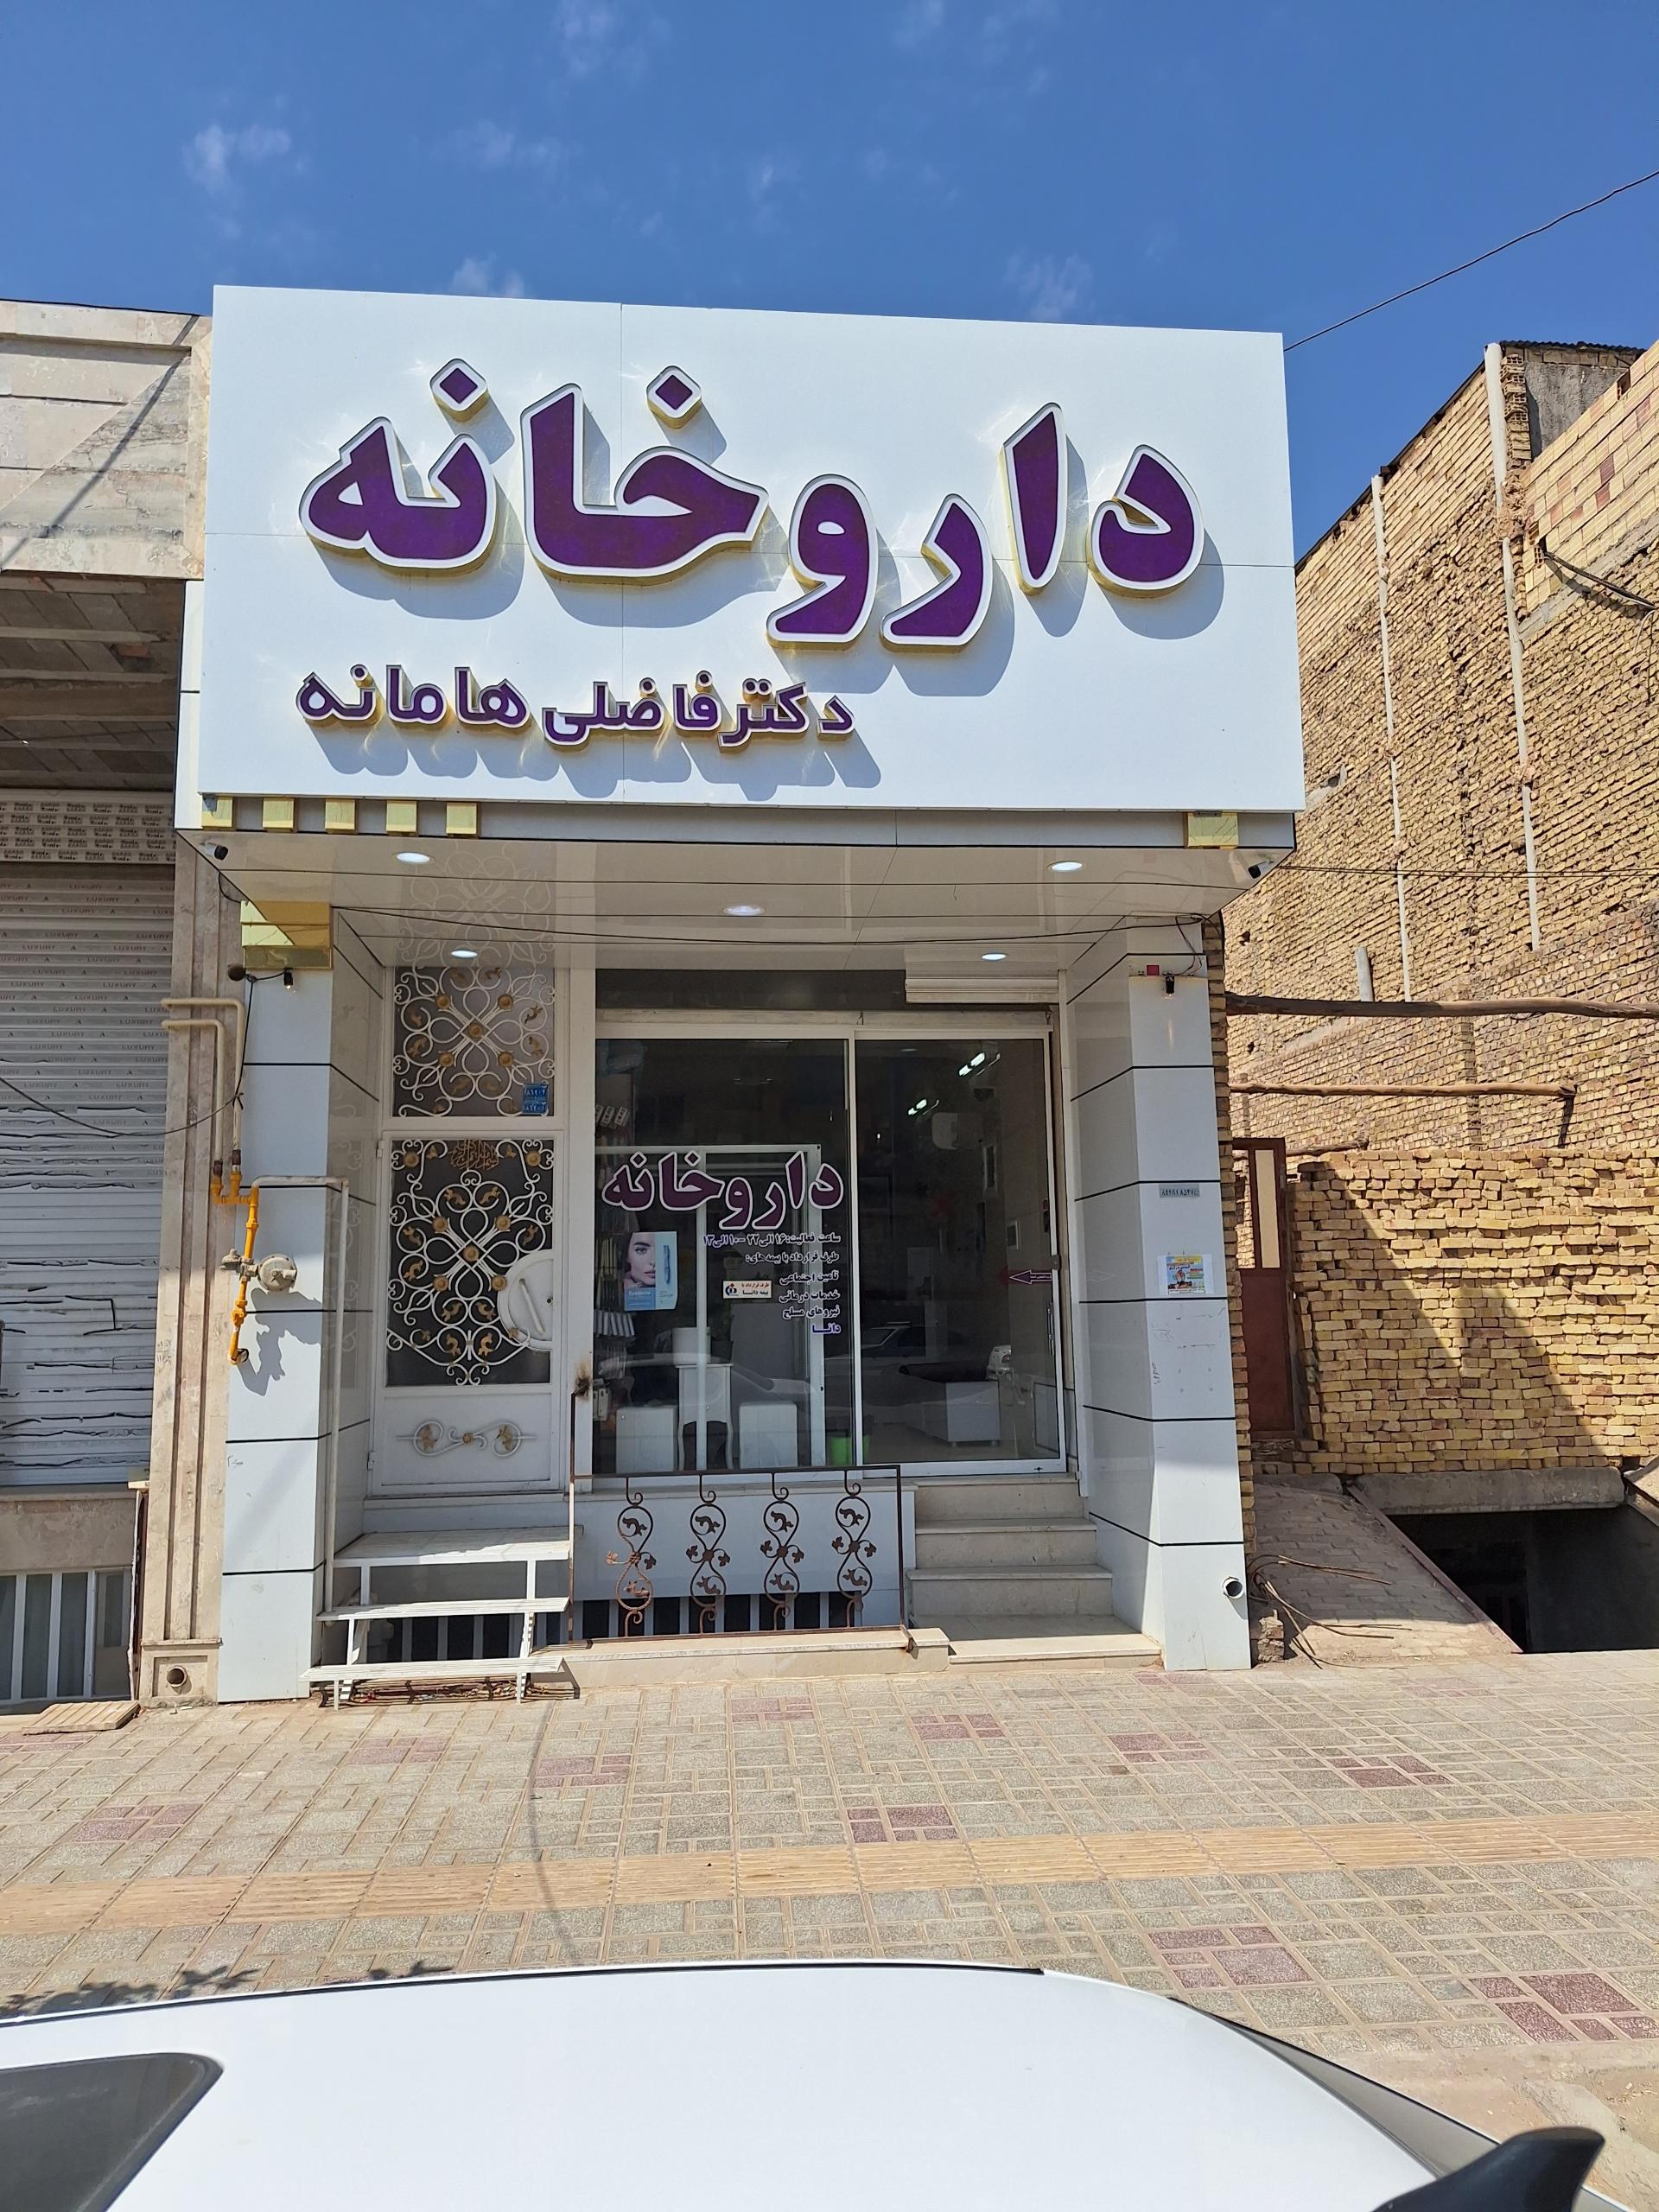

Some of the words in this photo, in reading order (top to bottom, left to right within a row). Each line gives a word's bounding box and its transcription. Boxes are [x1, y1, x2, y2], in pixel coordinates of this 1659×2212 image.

[299, 359, 1205, 652] داروخانه
[541, 670, 722, 751] فاضلی
[718, 676, 856, 754] دکتر
[601, 1150, 844, 1230] داروخانه
[818, 1232, 842, 1243] ساعت
[781, 1251, 789, 1263] با
[789, 1251, 818, 1263] قرارداد
[819, 1251, 839, 1264] طرف
[779, 1272, 816, 1286] اجتماعی
[817, 1269, 839, 1282] تامین
[779, 1289, 810, 1303] درمانی
[810, 1289, 841, 1300] خدمات
[782, 1306, 805, 1319] مسلح
[806, 1305, 841, 1319] نیروهای
